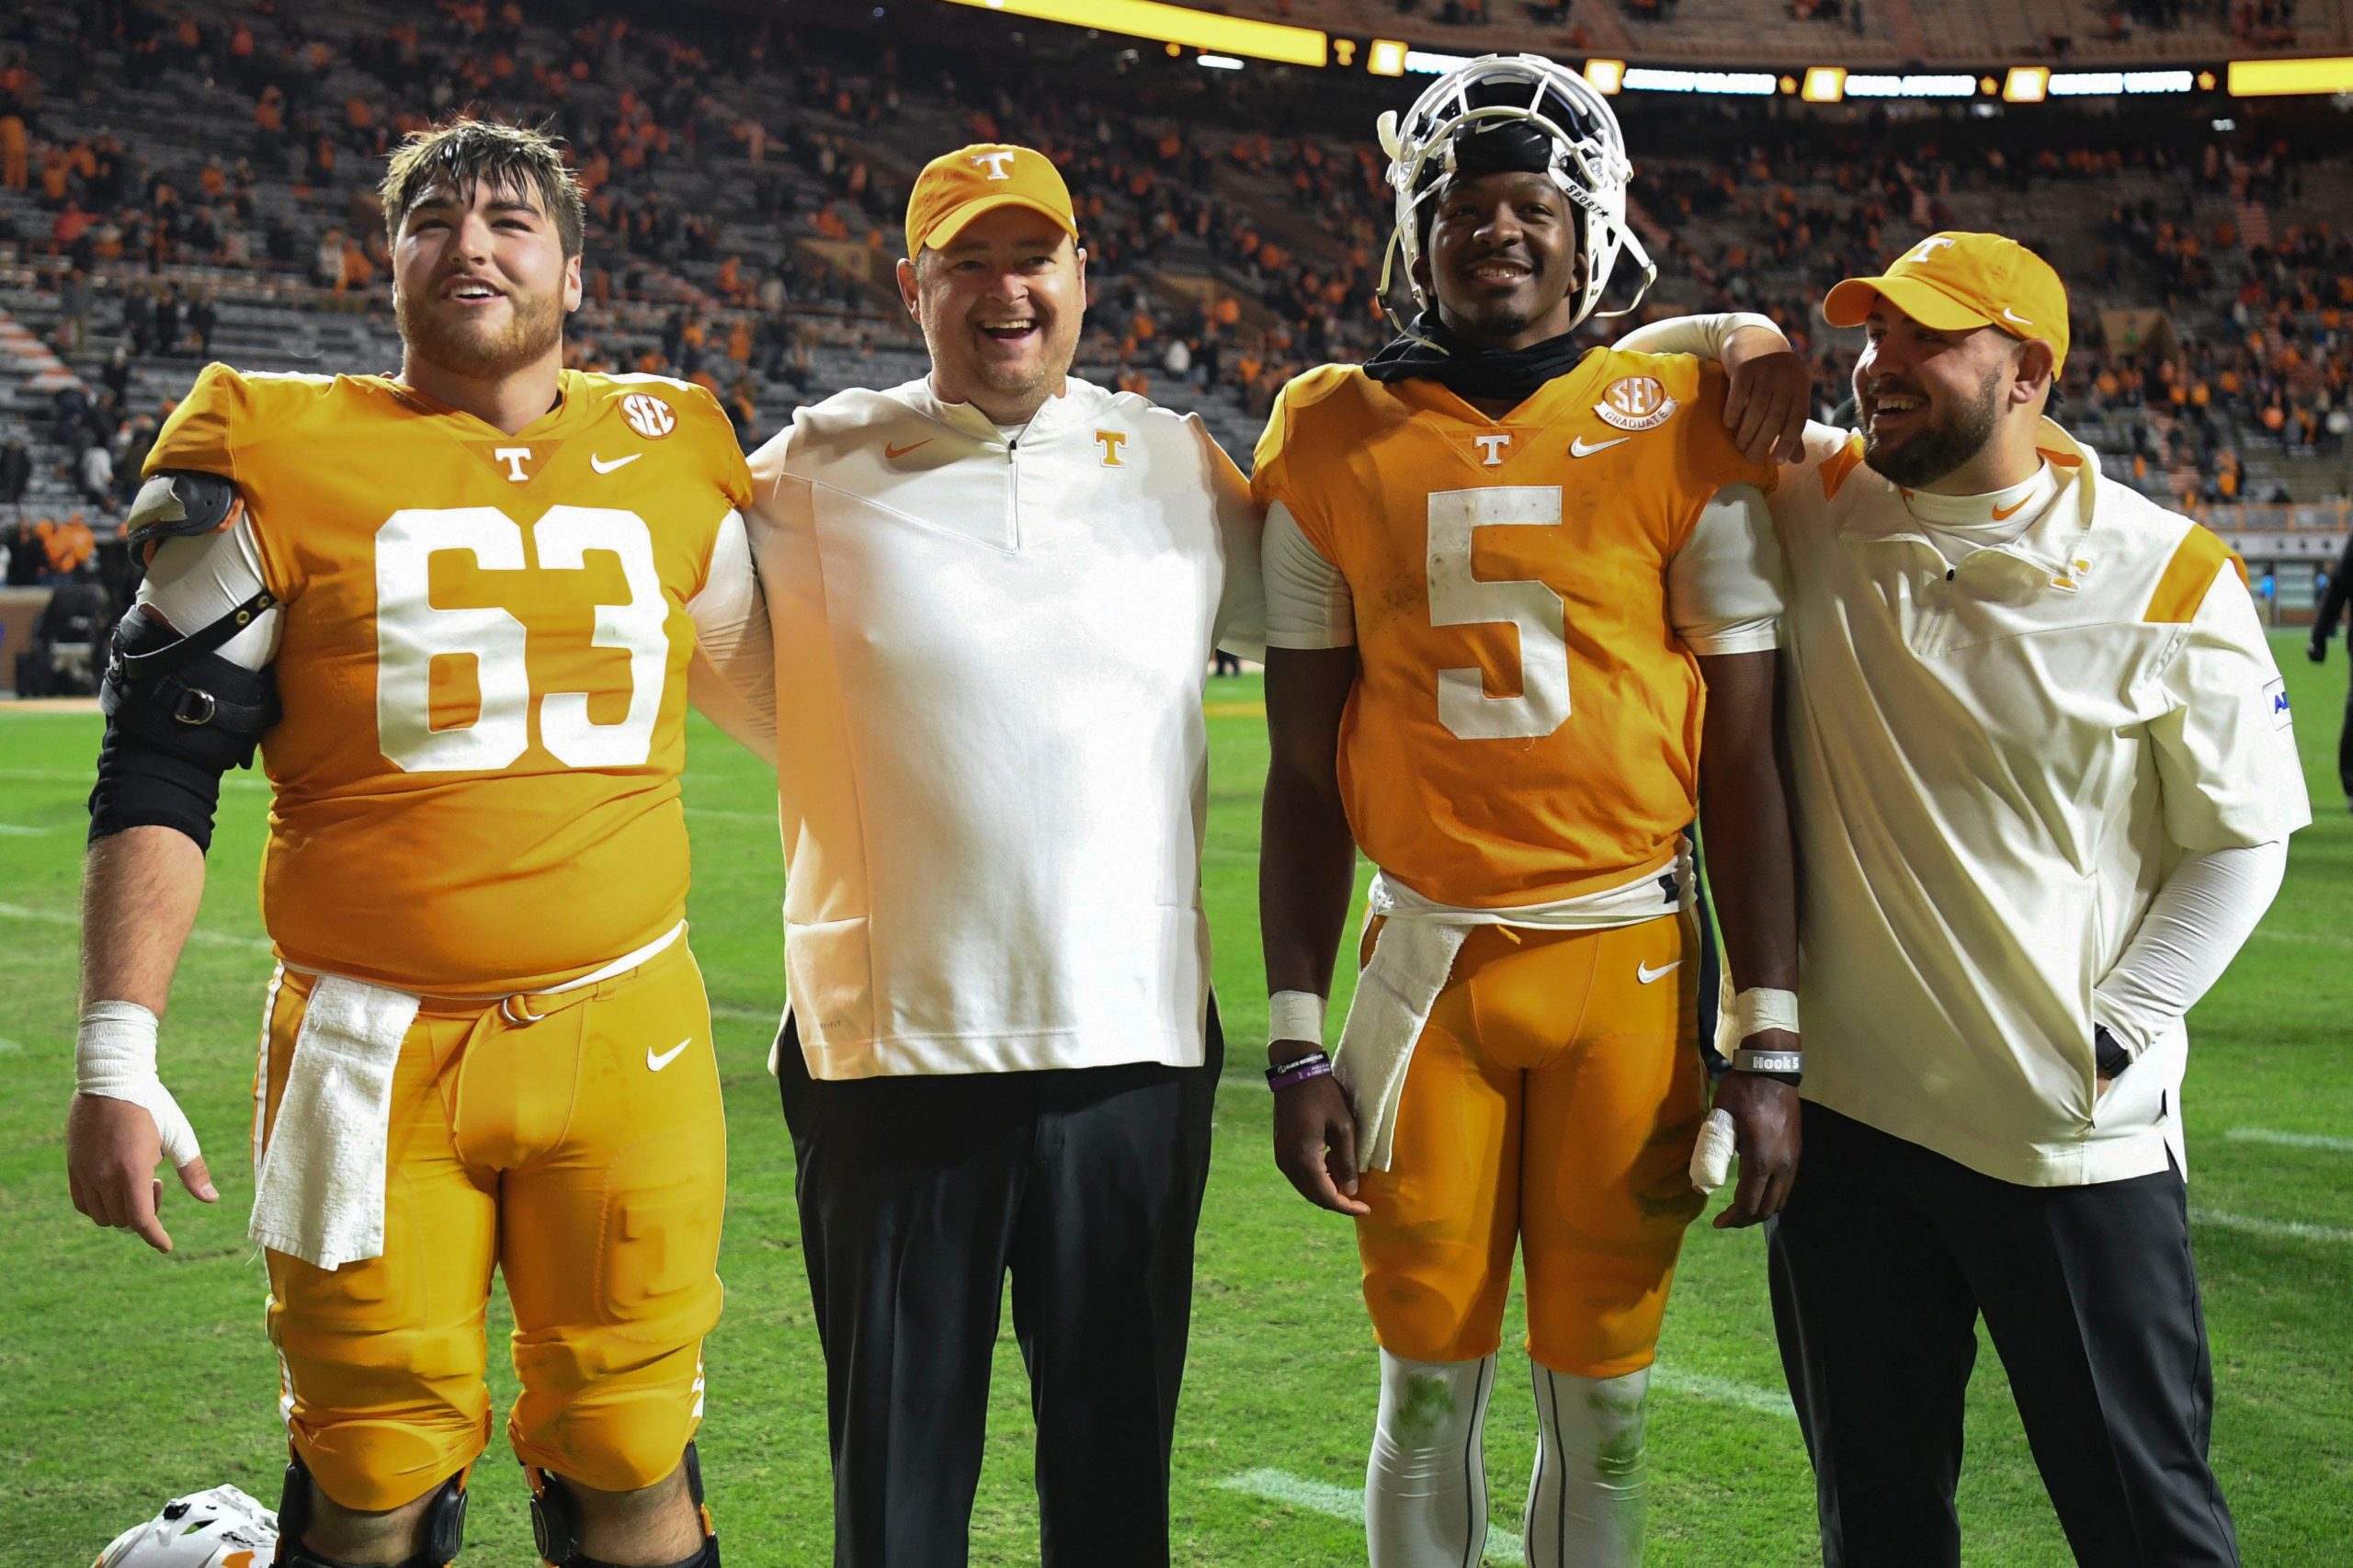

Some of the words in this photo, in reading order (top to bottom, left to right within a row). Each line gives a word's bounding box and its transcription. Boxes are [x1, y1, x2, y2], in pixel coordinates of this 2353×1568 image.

[971, 152, 1015, 180] T
[1565, 184, 1602, 217] SPORT
[1908, 237, 1957, 263] T
[1611, 377, 1659, 415] SEC
[622, 394, 675, 437] SEC
[1605, 409, 1668, 429] GRADUATE
[1095, 429, 1128, 467] T
[1476, 434, 1510, 465] T
[494, 448, 532, 482] T
[1427, 485, 1571, 740] 5
[375, 505, 669, 774] 63
[1753, 1055, 1791, 1070] Hook
